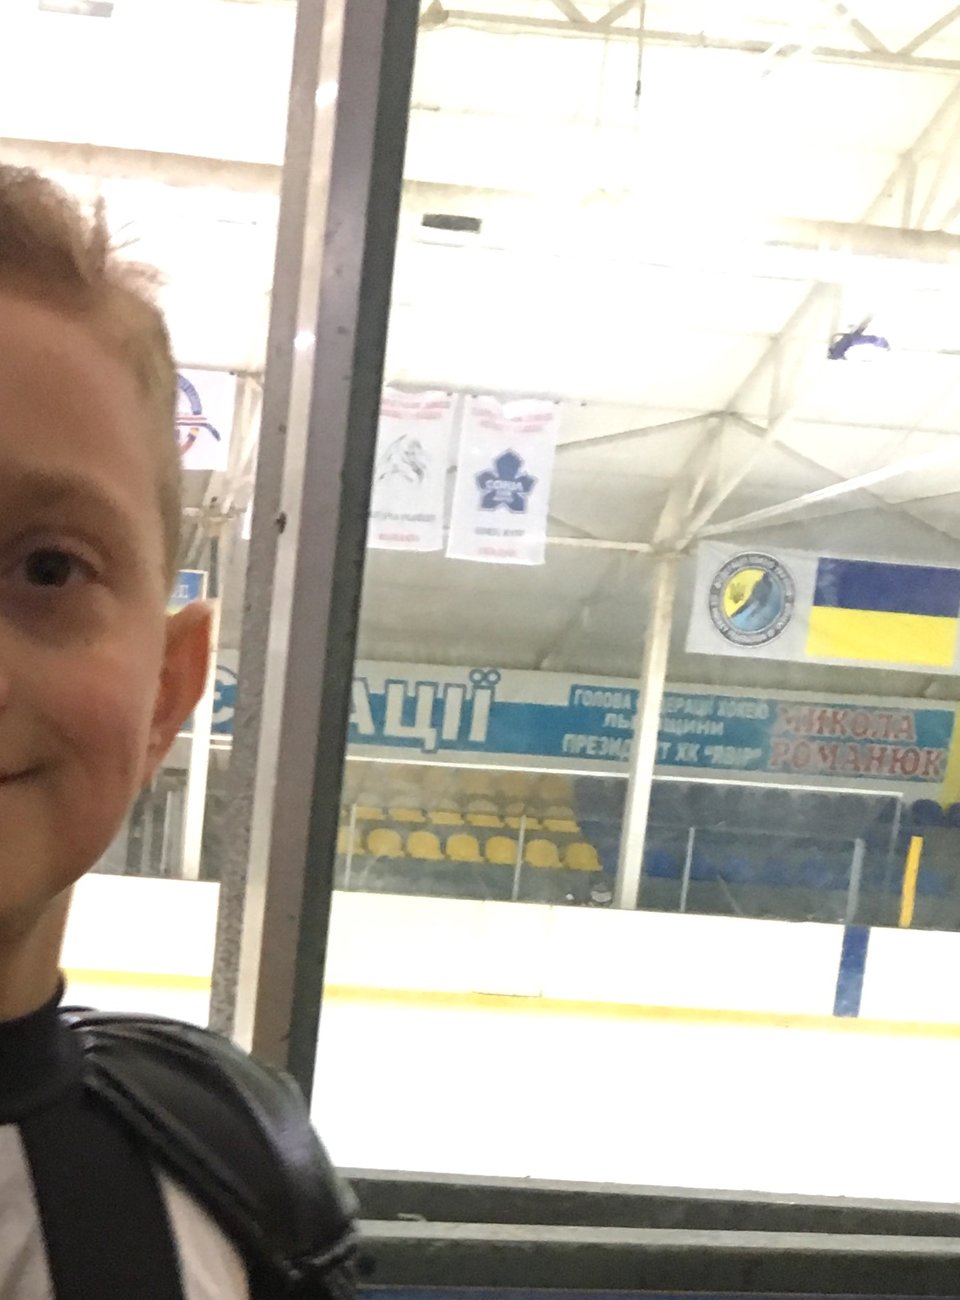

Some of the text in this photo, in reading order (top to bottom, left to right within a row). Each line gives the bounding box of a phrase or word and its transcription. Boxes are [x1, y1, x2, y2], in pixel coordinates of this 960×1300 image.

[349, 667, 501, 754] АЦІЇ
[777, 703, 915, 741] МИКОЛА
[769, 738, 944, 778] РОМАНЮК
